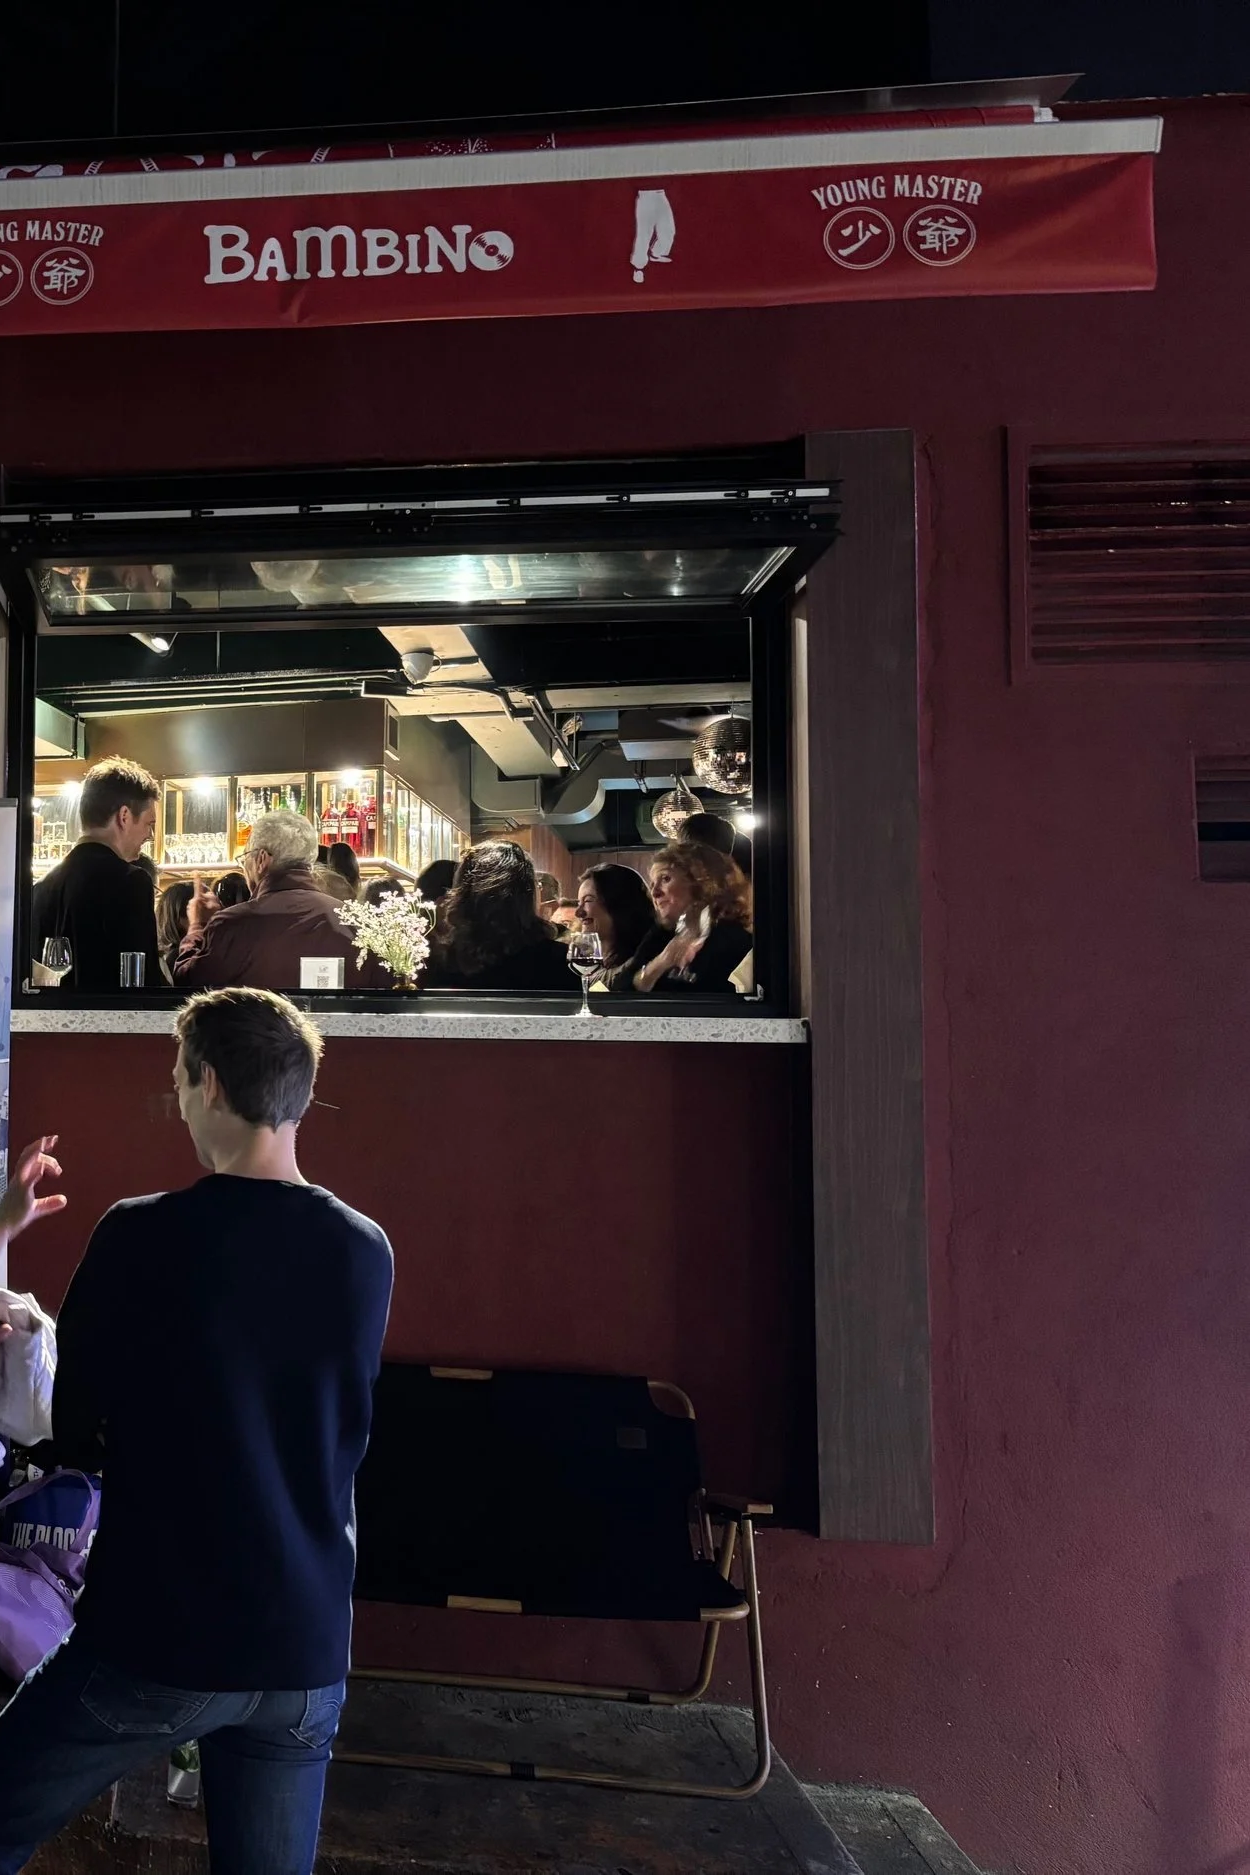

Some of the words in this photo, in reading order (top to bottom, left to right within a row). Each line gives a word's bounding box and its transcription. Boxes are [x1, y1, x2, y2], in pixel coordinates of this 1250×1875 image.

[811, 175, 887, 210] YOUNG
[894, 174, 983, 206] MASTER
[25, 220, 104, 247] MASTER
[203, 224, 514, 285] BAMBINO
